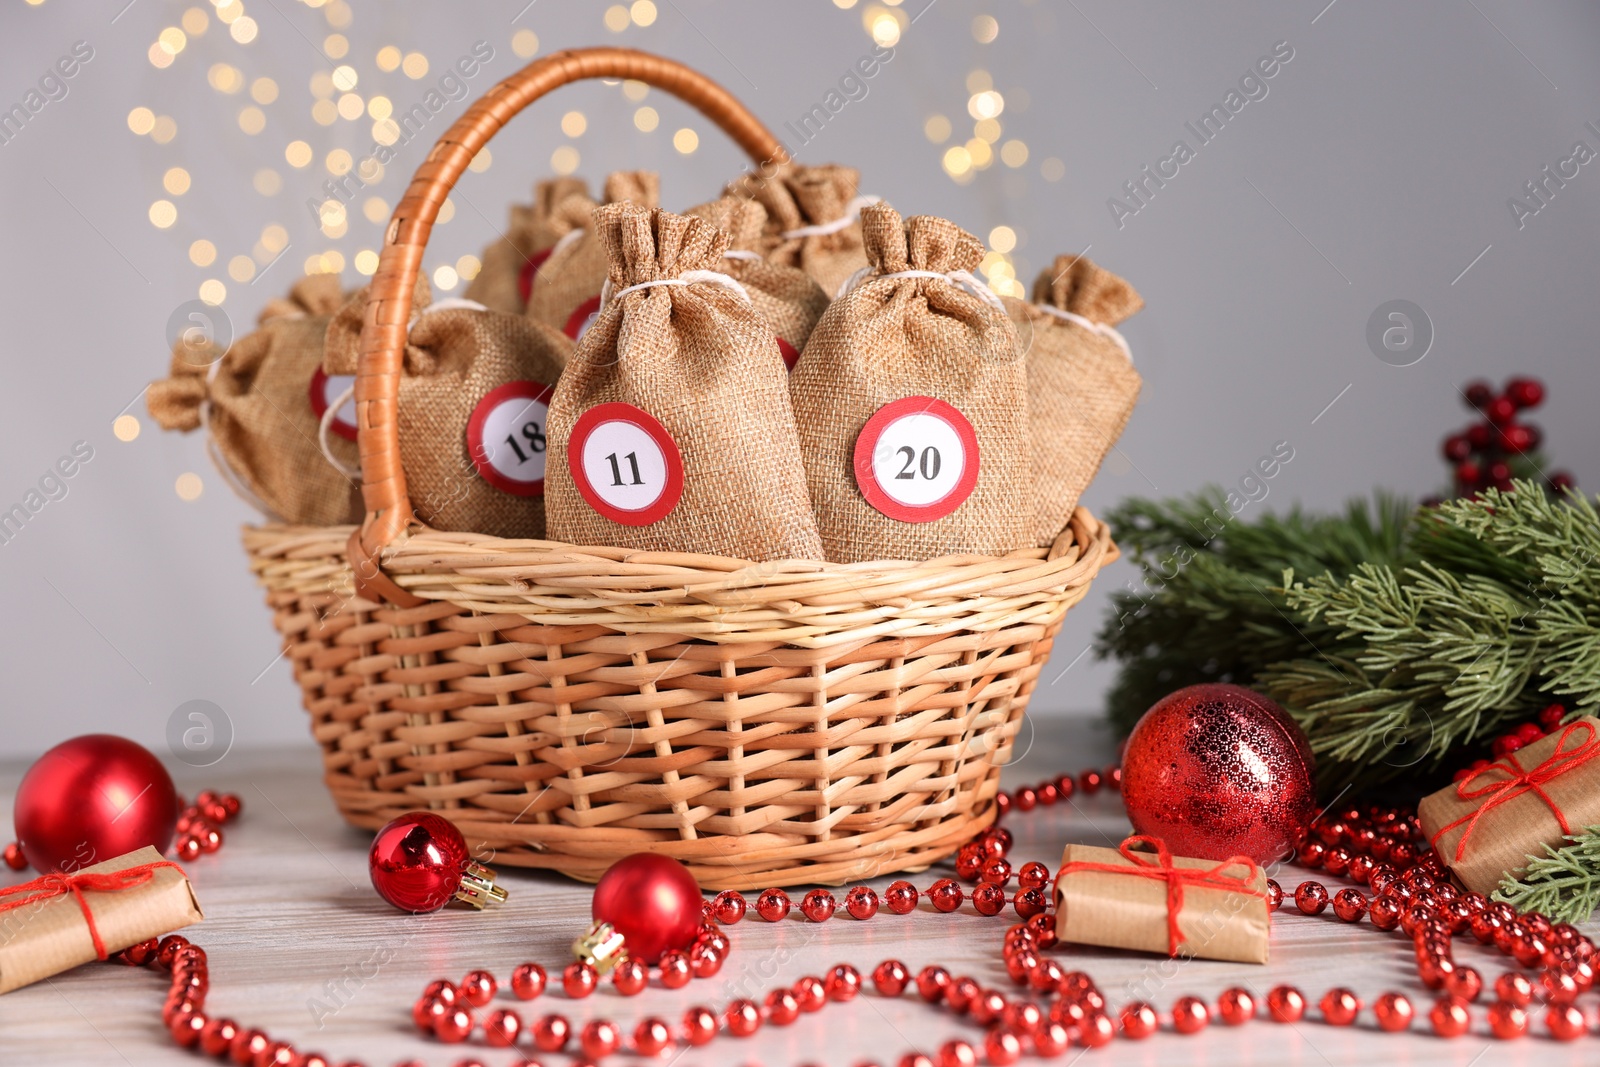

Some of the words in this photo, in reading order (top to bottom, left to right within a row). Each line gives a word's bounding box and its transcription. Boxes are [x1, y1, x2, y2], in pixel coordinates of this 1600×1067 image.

[504, 421, 546, 466] 18
[605, 451, 646, 487] 11
[894, 445, 942, 481] 20
